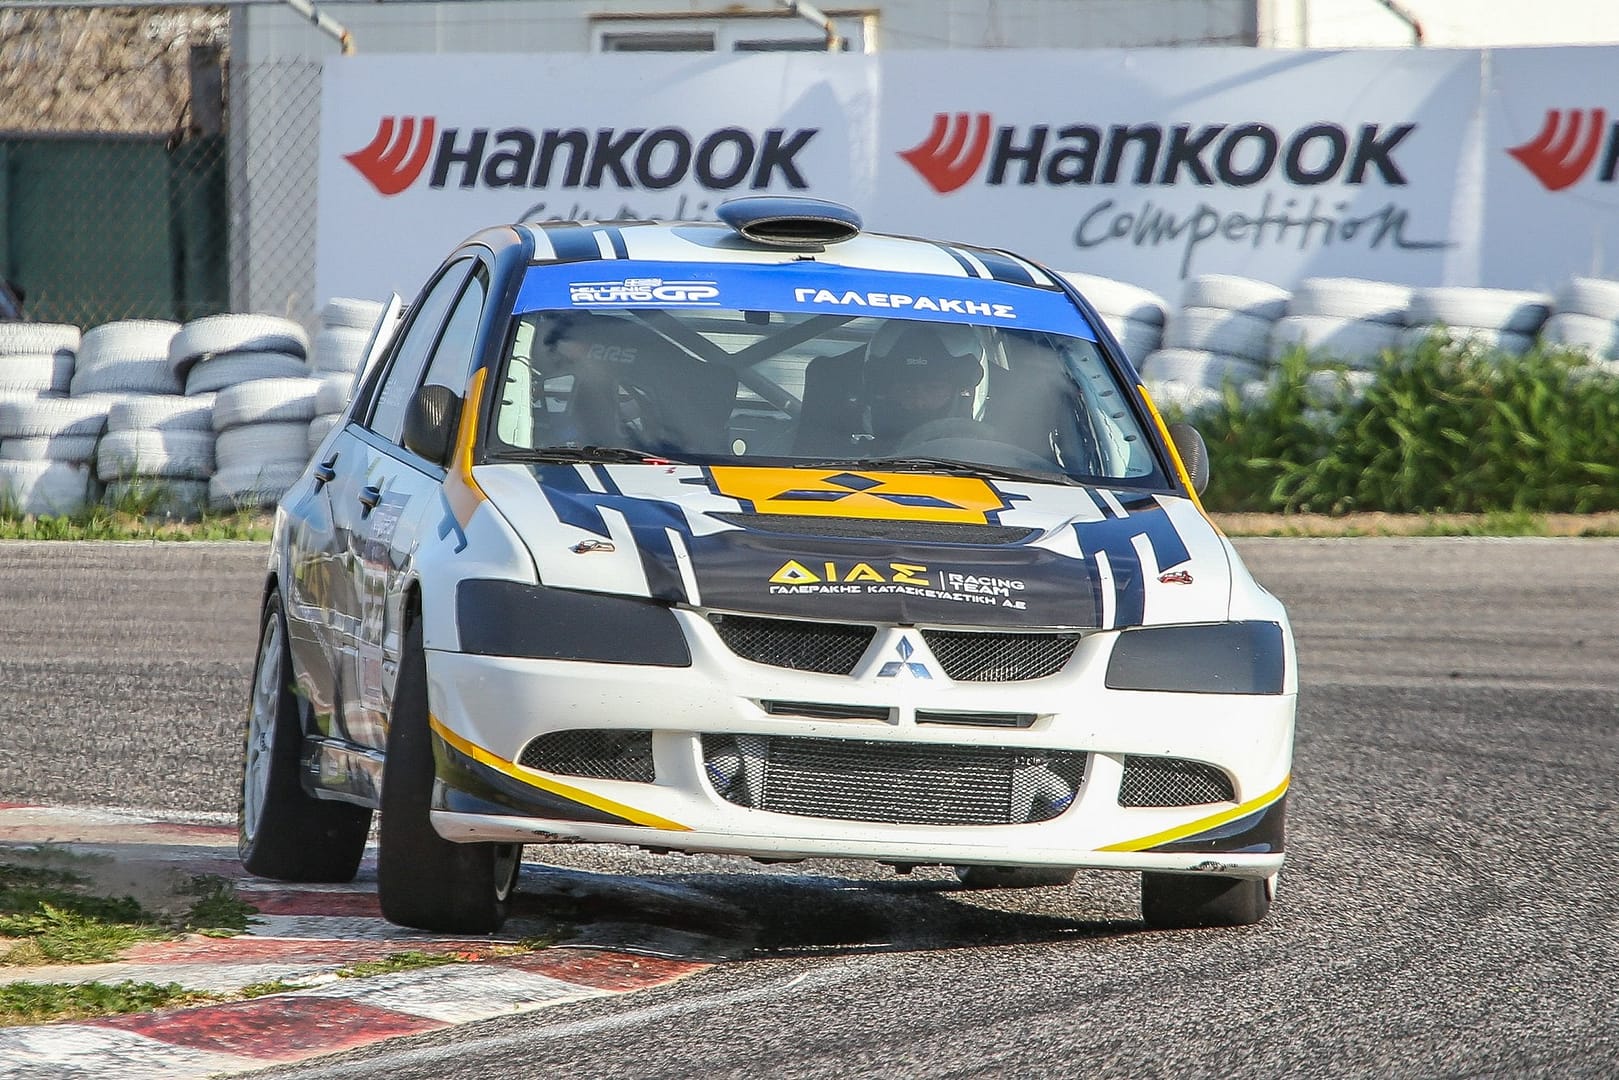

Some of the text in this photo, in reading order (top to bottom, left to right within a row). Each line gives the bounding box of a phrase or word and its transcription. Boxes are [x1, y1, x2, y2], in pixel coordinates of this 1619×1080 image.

[794, 288, 1017, 319] ΓΑΛΕΡΑΚΗΣ
[768, 559, 930, 586] ΔΙΑΣ
[948, 573, 1025, 590] RACING
[769, 585, 862, 594] ΓΑΛΕΡΑΚΗΣ
[867, 585, 997, 605] ΚΑΤΑΣΚΕΥΑΣΤΙΚΗ
[949, 581, 1010, 597] TEAM
